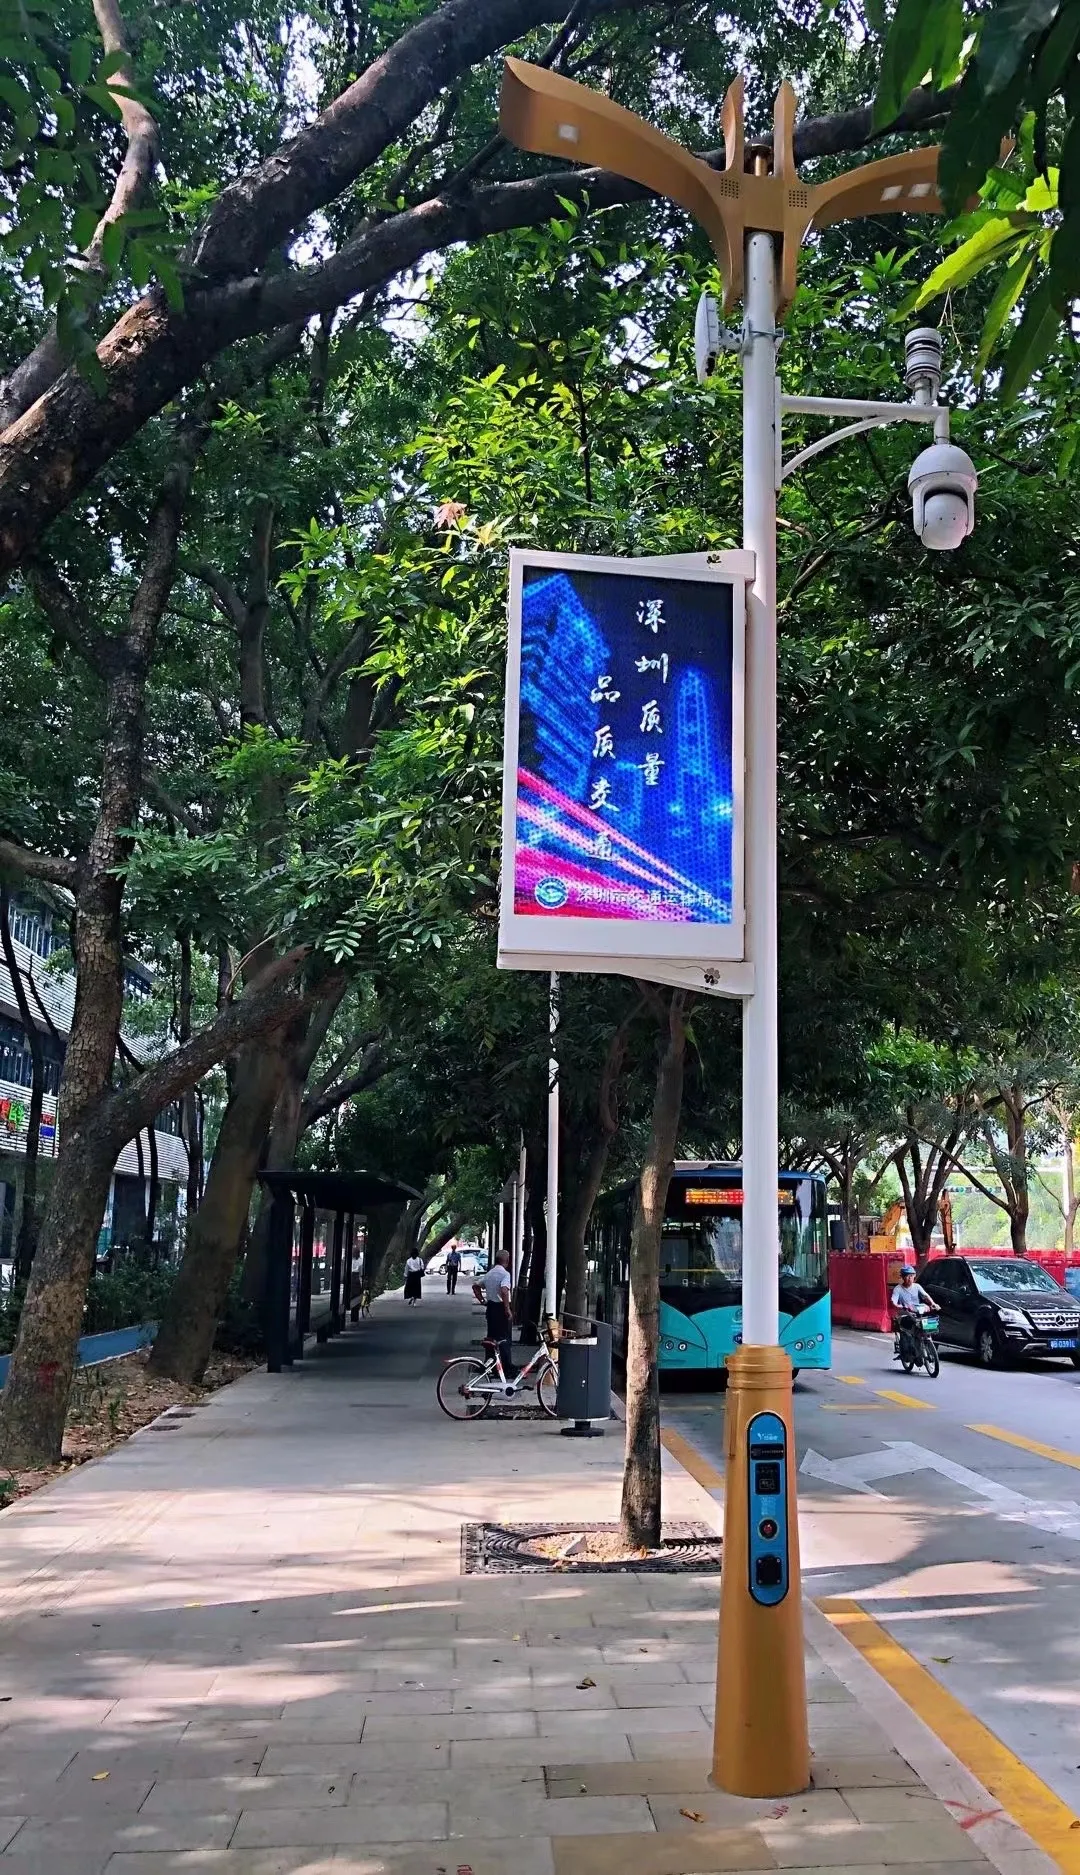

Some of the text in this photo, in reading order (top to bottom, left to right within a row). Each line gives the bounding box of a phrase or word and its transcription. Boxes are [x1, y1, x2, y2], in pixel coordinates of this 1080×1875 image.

[589, 674, 619, 861] 品质交通
[635, 599, 668, 786] 深圳质量
